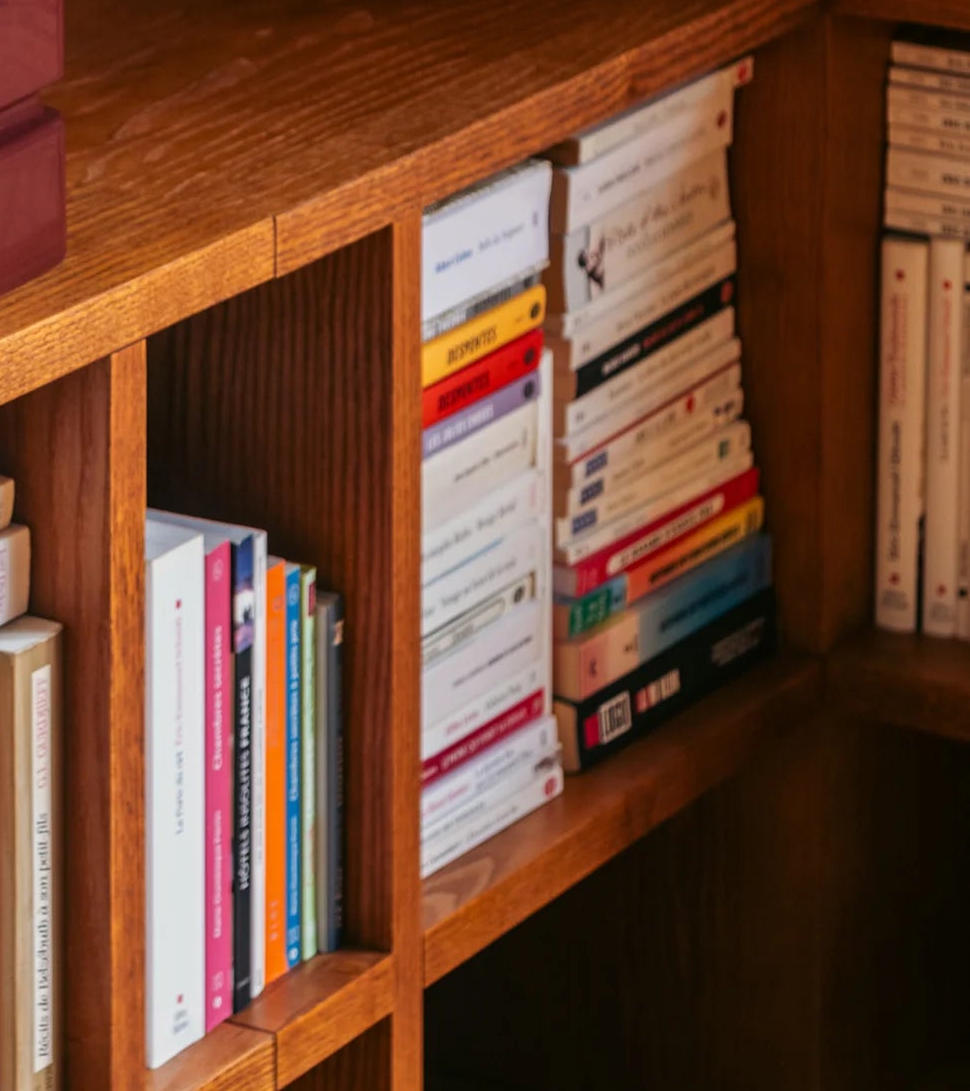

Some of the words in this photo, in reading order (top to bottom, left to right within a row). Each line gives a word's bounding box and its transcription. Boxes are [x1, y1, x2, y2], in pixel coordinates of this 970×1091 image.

[447, 327, 498, 366] DESPENTES
[438, 371, 490, 413] DESPENTES
[212, 625, 223, 688] secrètes
[212, 690, 223, 771] Chambres
[240, 676, 252, 746] FRANCE
[239, 750, 251, 827] INSOLITES
[238, 830, 250, 890] HÔTELS
[38, 876, 48, 900] son
[37, 905, 48, 916] à
[38, 995, 49, 1011] de
[37, 1014, 50, 1057] Récits
